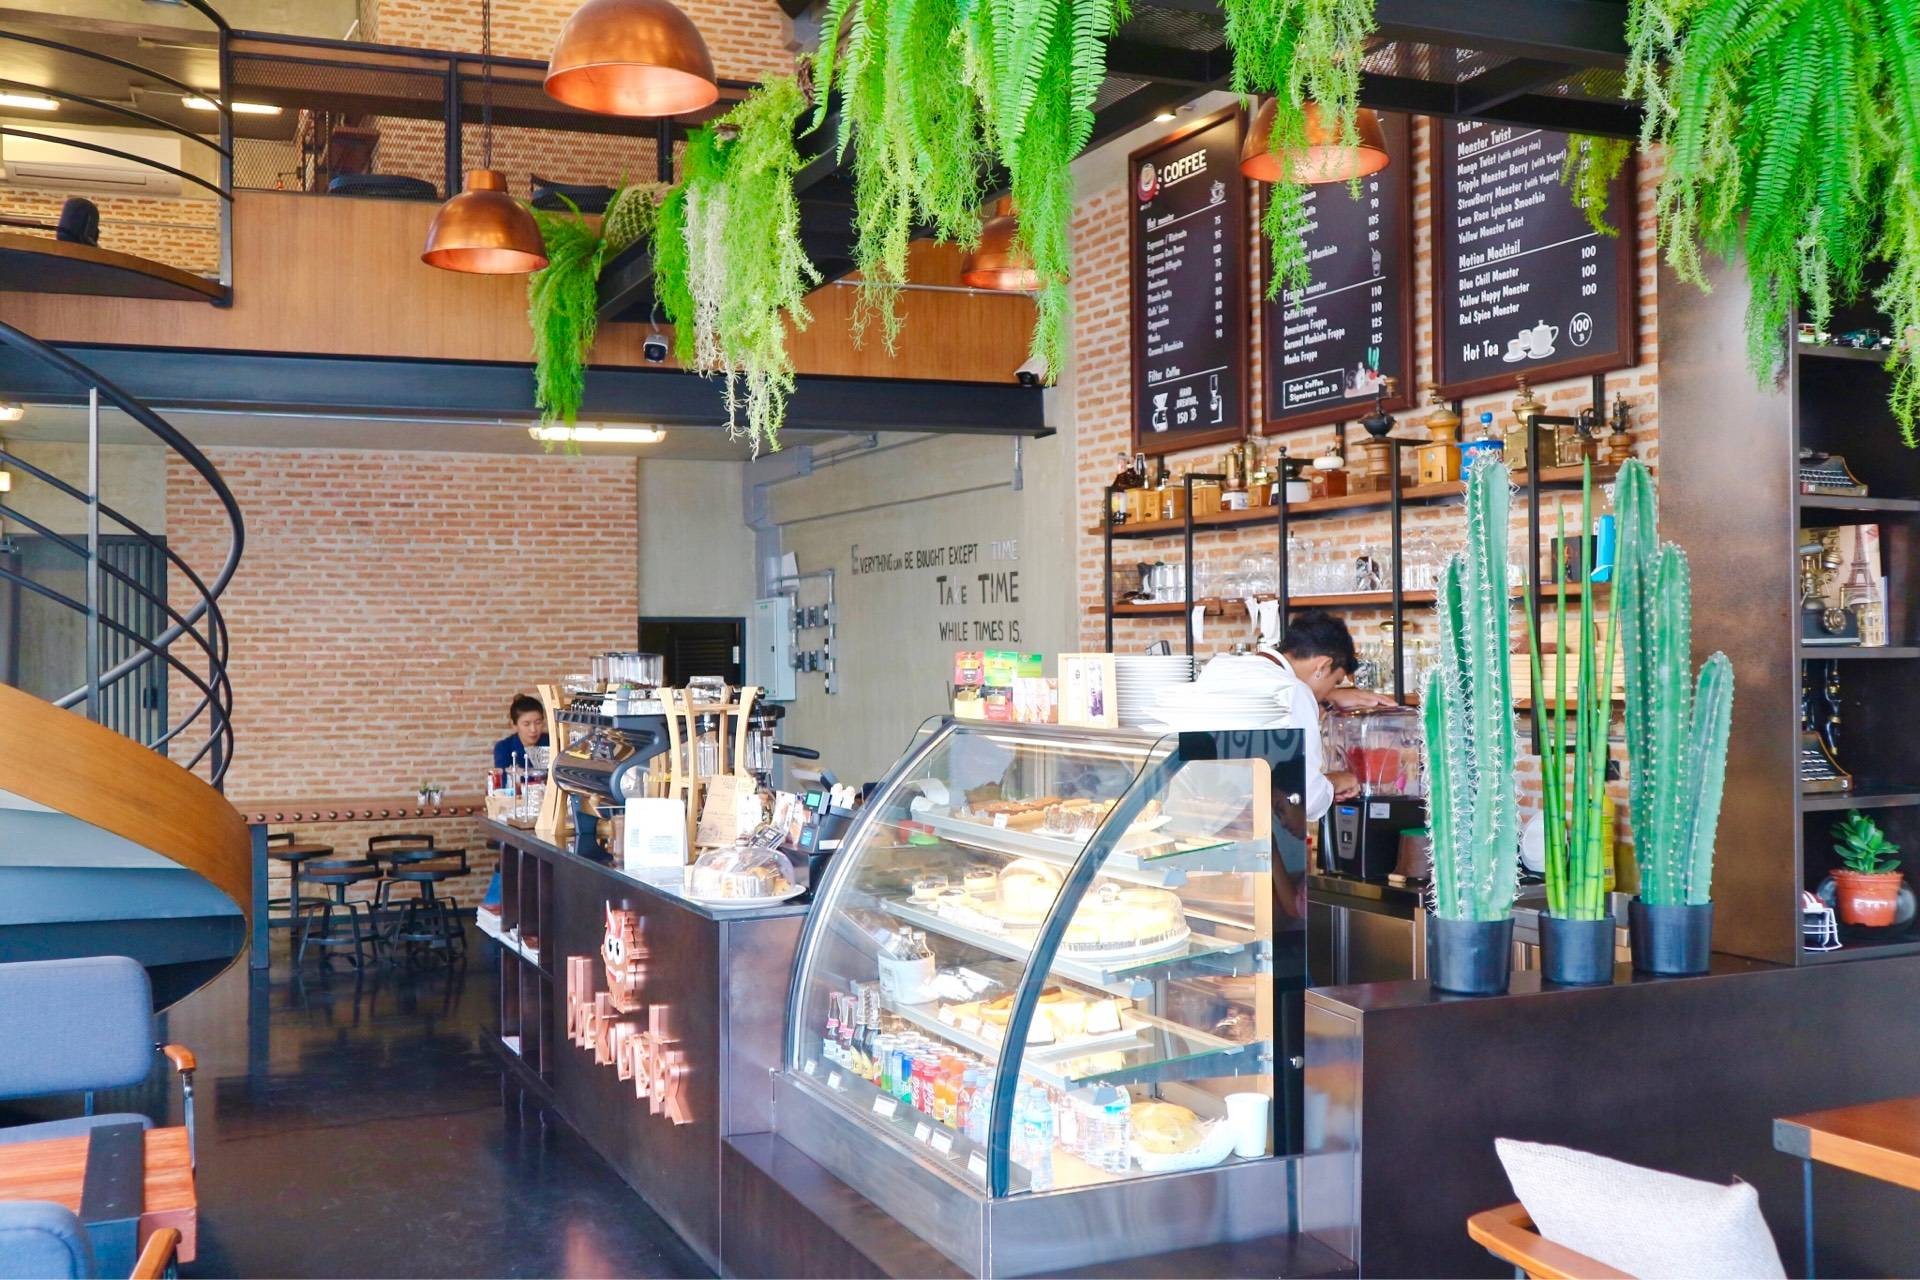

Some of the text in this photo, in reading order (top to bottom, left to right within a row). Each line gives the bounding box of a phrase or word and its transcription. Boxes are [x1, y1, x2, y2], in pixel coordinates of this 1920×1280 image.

[1457, 121, 1472, 135] Thai
[1457, 127, 1512, 157] Monster Twist
[1163, 148, 1207, 183] COFFEE
[1479, 153, 1497, 168] Twist
[1481, 169, 1508, 186] Monster
[1509, 161, 1529, 177] Berry
[1494, 181, 1523, 198] Monster
[1514, 191, 1546, 210] Smoothie
[1458, 231, 1479, 245] Yellow
[1480, 222, 1506, 239] Monster
[1506, 216, 1524, 230] Twist
[1459, 239, 1521, 269] Motion Mocktail
[1459, 245, 1597, 292] Blue Chill Monster 100
[1371, 285, 1382, 297] 110
[1459, 264, 1597, 309] Yellow Happy Monster 100
[1371, 301, 1383, 313] 110
[1459, 282, 1598, 326] Red Spice Monster 100
[1371, 316, 1383, 329] 125
[1371, 333, 1383, 344] 125
[1463, 318, 1590, 362] Hot Tea 100
[904, 552, 914, 570] BE
[917, 547, 945, 569] BOUGHT
[949, 544, 978, 566] EXCEPT
[991, 539, 1020, 560] TIME
[977, 571, 1019, 604] TIME
[939, 621, 969, 642] WHILE
[973, 620, 1004, 642] TIMES
